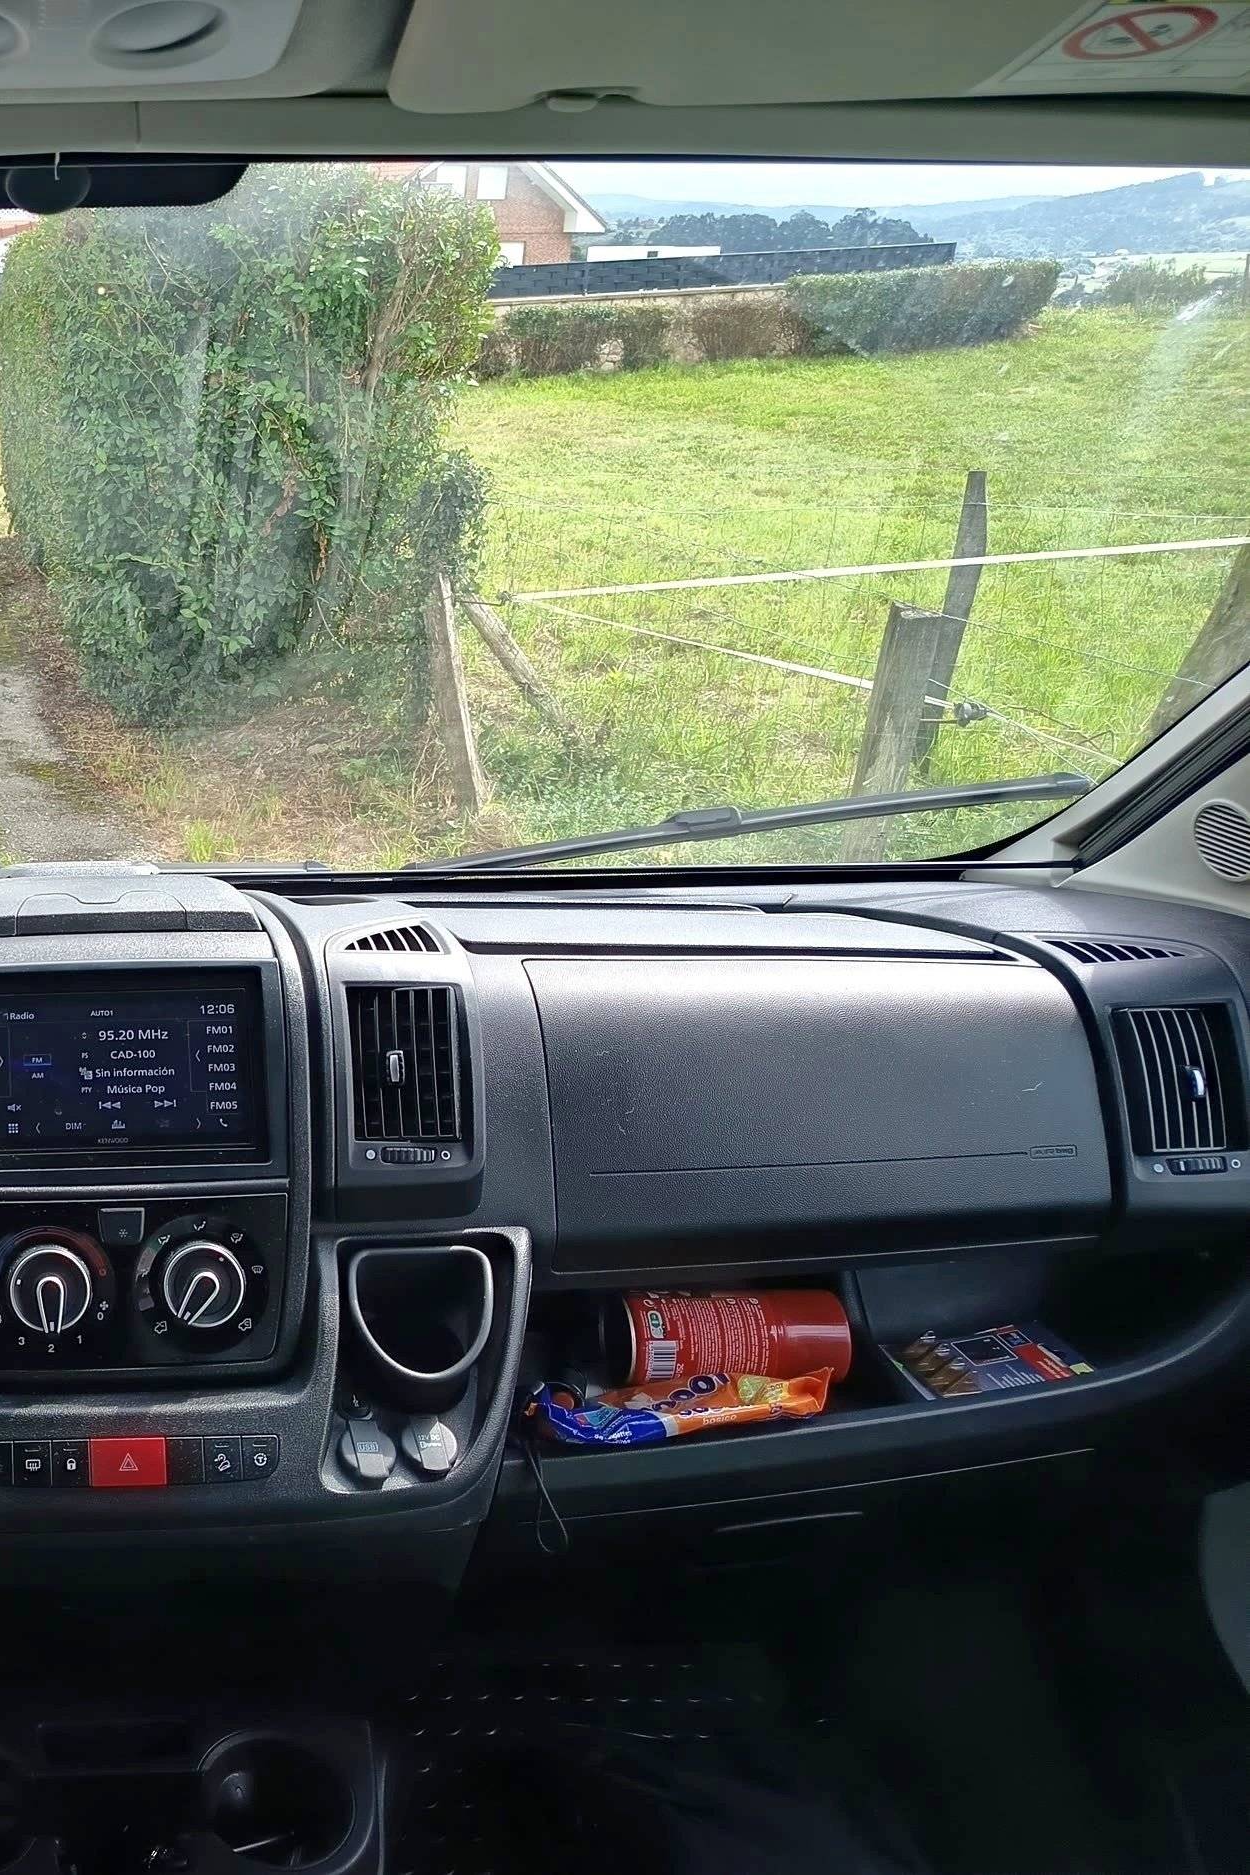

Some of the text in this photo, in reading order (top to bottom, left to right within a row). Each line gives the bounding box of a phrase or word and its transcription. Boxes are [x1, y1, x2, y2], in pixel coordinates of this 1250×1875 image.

[199, 1003, 235, 1015] 12:06
[10, 1012, 35, 1020] Radio
[206, 1025, 233, 1035] FM01
[98, 1029, 169, 1041] 95.20 MHz
[207, 1044, 235, 1053] FM02
[110, 1049, 156, 1059] CAD-100
[95, 1066, 175, 1078] Sin información
[208, 1063, 236, 1072] FM03
[106, 1084, 143, 1094] Música
[145, 1084, 166, 1095] Pop
[209, 1082, 237, 1091] FM04
[210, 1101, 238, 1110] FM05
[65, 1122, 82, 1130] DIM
[97, 1311, 104, 1321] 0
[18, 1336, 25, 1346] 3
[76, 1335, 82, 1344] 1
[47, 1344, 55, 1353] 2
[358, 1443, 377, 1451] USB
